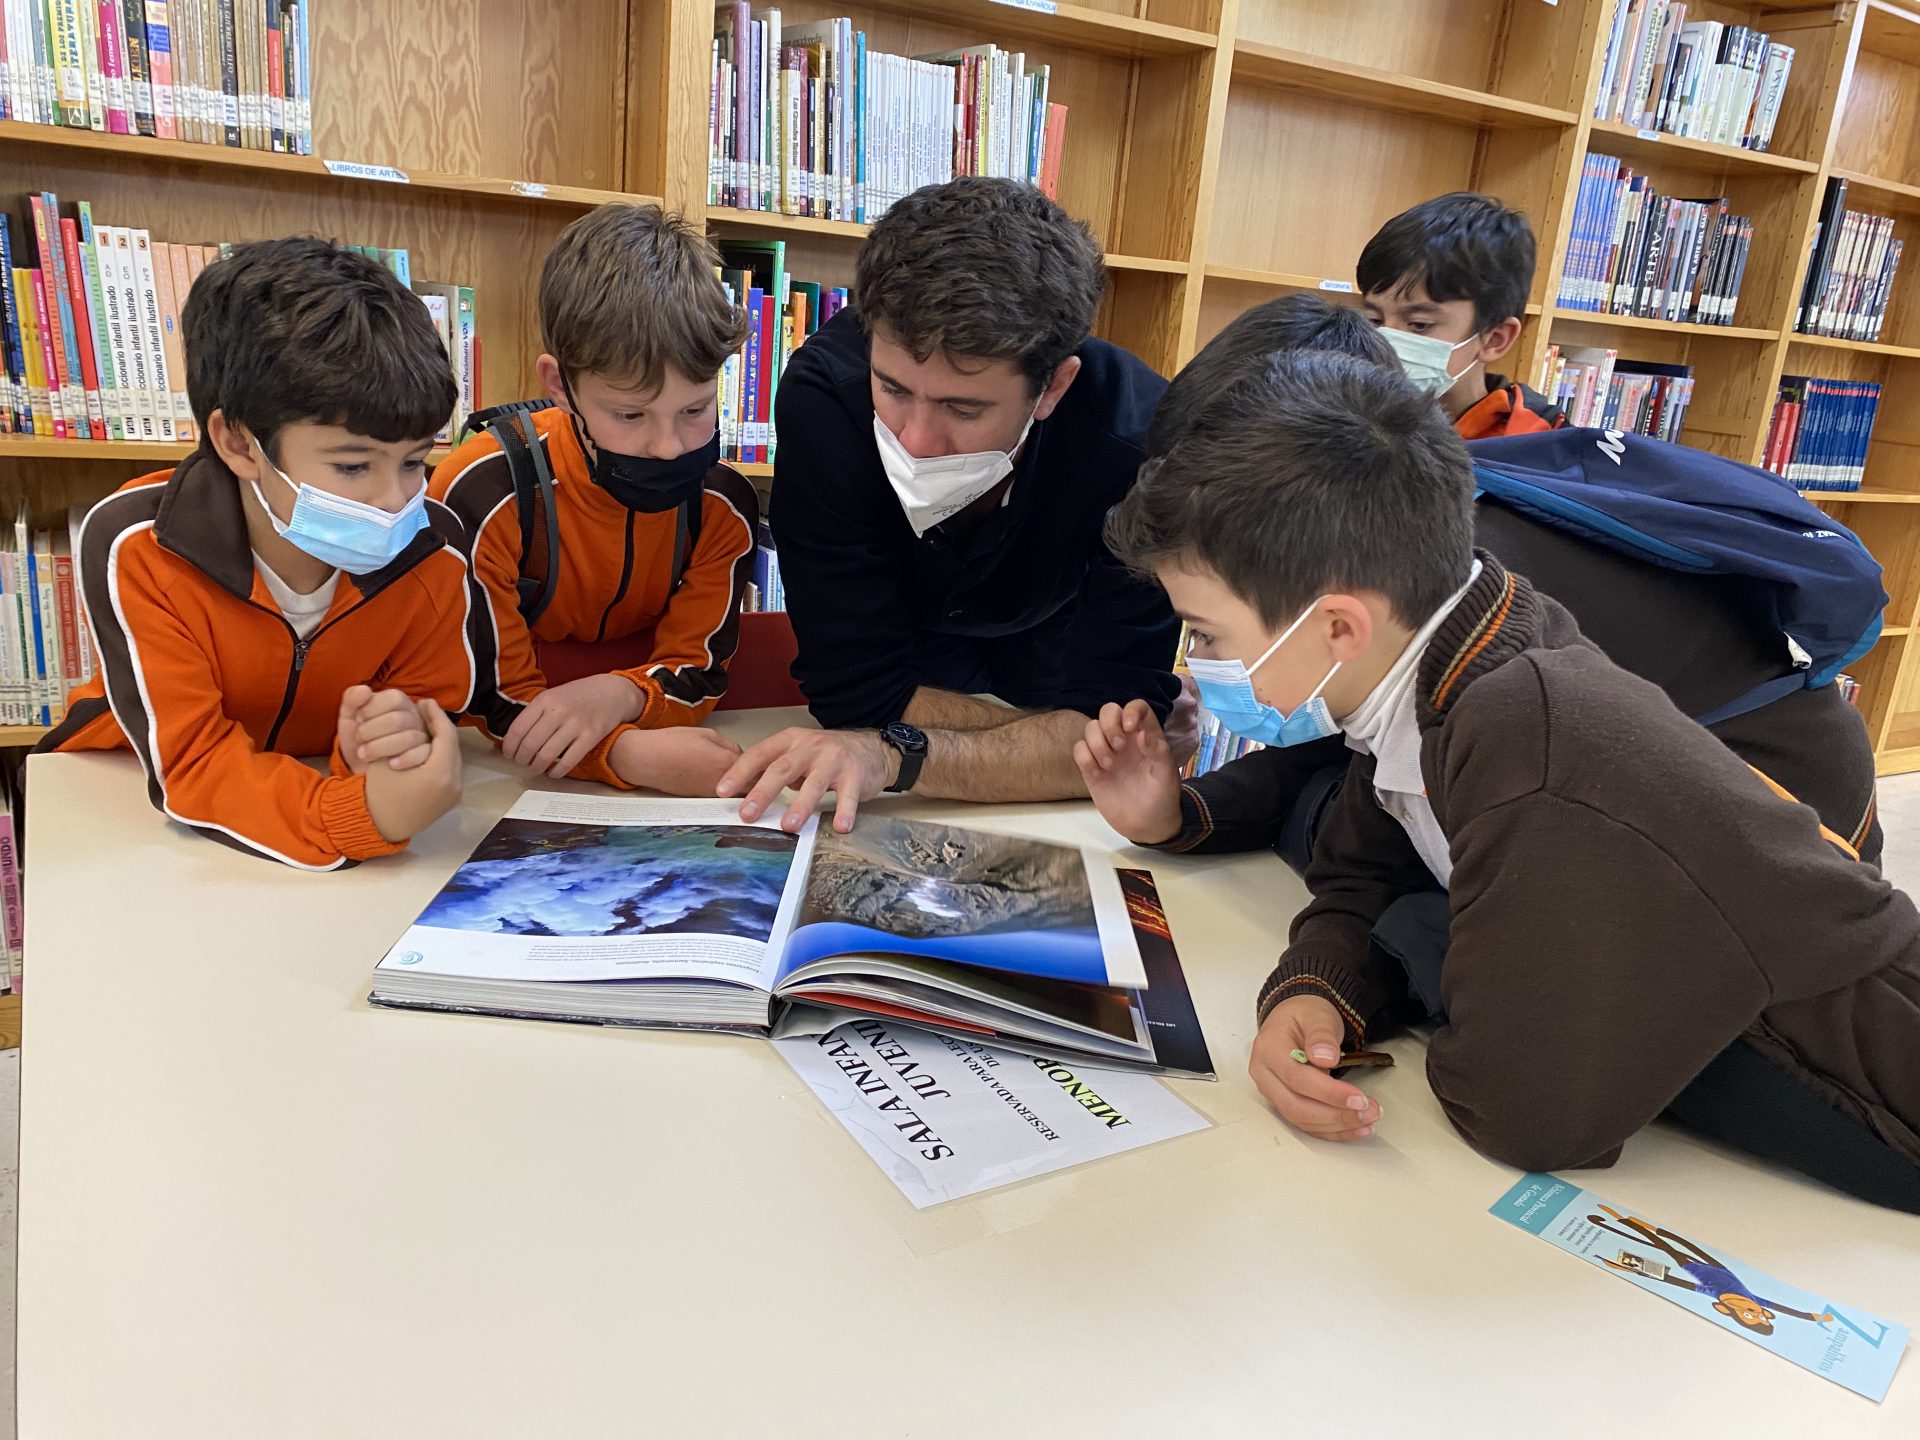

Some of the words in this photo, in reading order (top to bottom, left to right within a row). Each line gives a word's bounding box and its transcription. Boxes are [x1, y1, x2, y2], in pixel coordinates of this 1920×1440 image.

[64, 0, 80, 68] ITERATURA
[105, 22, 116, 67] femenino
[128, 36, 143, 82] LKIEN
[1763, 68, 1784, 114] ESPASA
[332, 163, 363, 175] LIBROS
[364, 167, 377, 176] DE
[1644, 231, 1662, 282] ARTE
[4, 289, 13, 324] NOUVEAU
[106, 285, 121, 322] ilustrado
[124, 287, 139, 323] ilustrado
[146, 289, 158, 324] ilustrado
[113, 322, 126, 349] infantil
[130, 325, 144, 351] infantil
[149, 325, 162, 352] infantil
[115, 350, 130, 390] iccionario
[133, 352, 148, 391] iccionario
[153, 353, 167, 392] iccionario
[749, 367, 757, 393] ATLAS
[747, 394, 755, 421] RIMER
[811, 1029, 892, 1096] INFAN
[963, 1056, 994, 1083] PARA
[979, 1053, 1001, 1068] DE
[991, 1080, 1060, 1141] RESERVADA
[1030, 1055, 1132, 1130] MENOR
[878, 1094, 954, 1161] SALA
[1513, 1188, 1537, 1208] Granada
[1540, 1183, 1565, 1203] Biblioteca
[1519, 1200, 1547, 1224] Provincial
